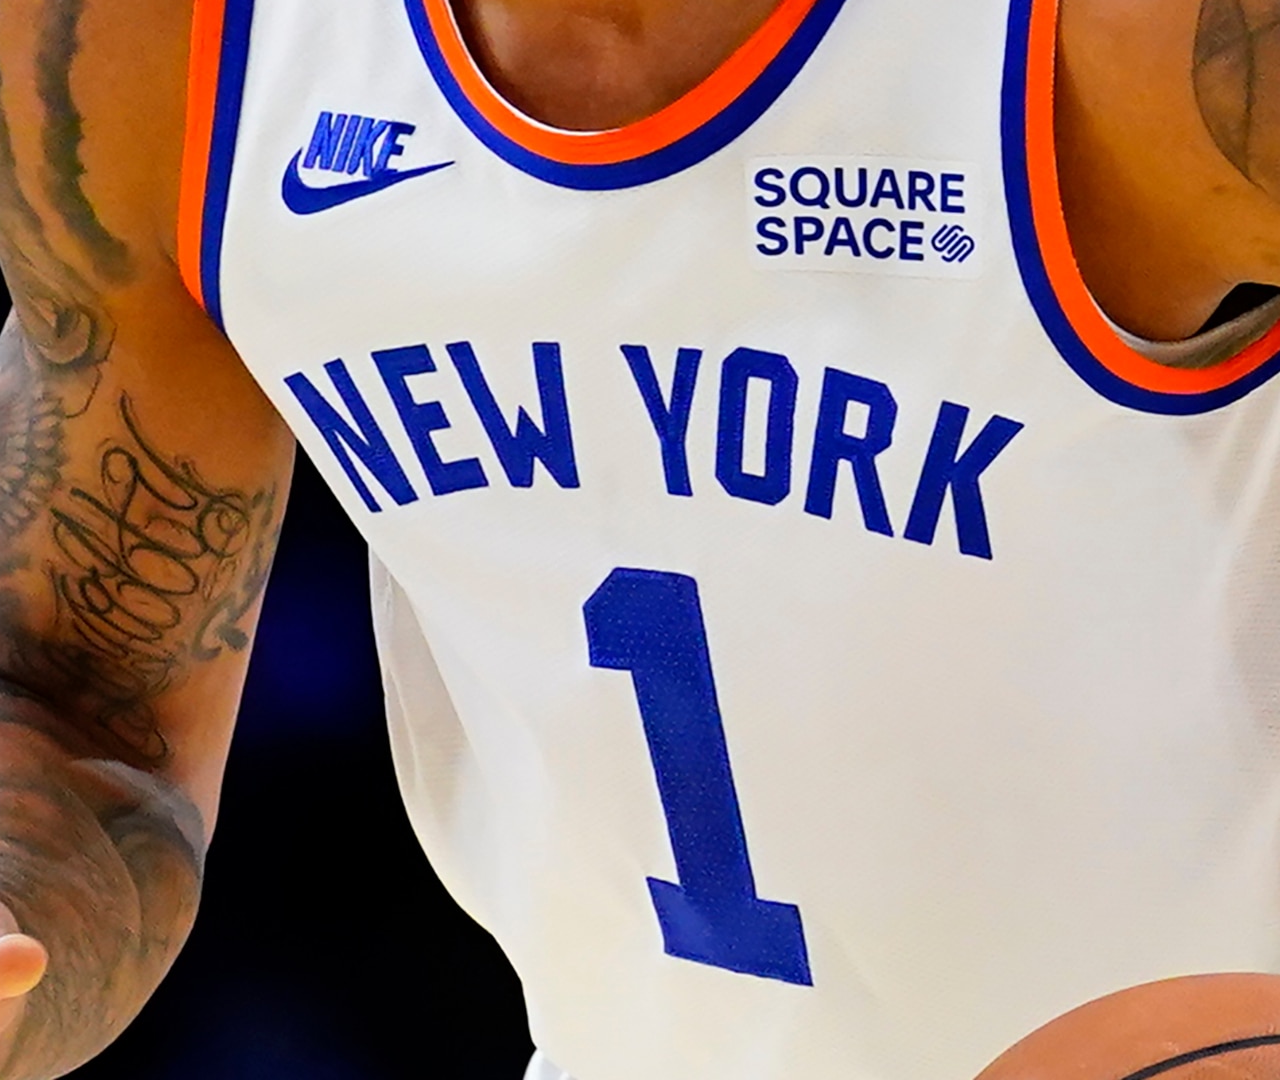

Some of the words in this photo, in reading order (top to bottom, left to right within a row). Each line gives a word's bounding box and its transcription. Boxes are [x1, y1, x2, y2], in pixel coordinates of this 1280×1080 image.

[302, 111, 417, 178] NIKE
[754, 167, 966, 214] SQUARE
[756, 215, 926, 262] SPACE
[283, 340, 581, 514] NEW
[619, 344, 1025, 561] YORK
[582, 566, 814, 987] 1
